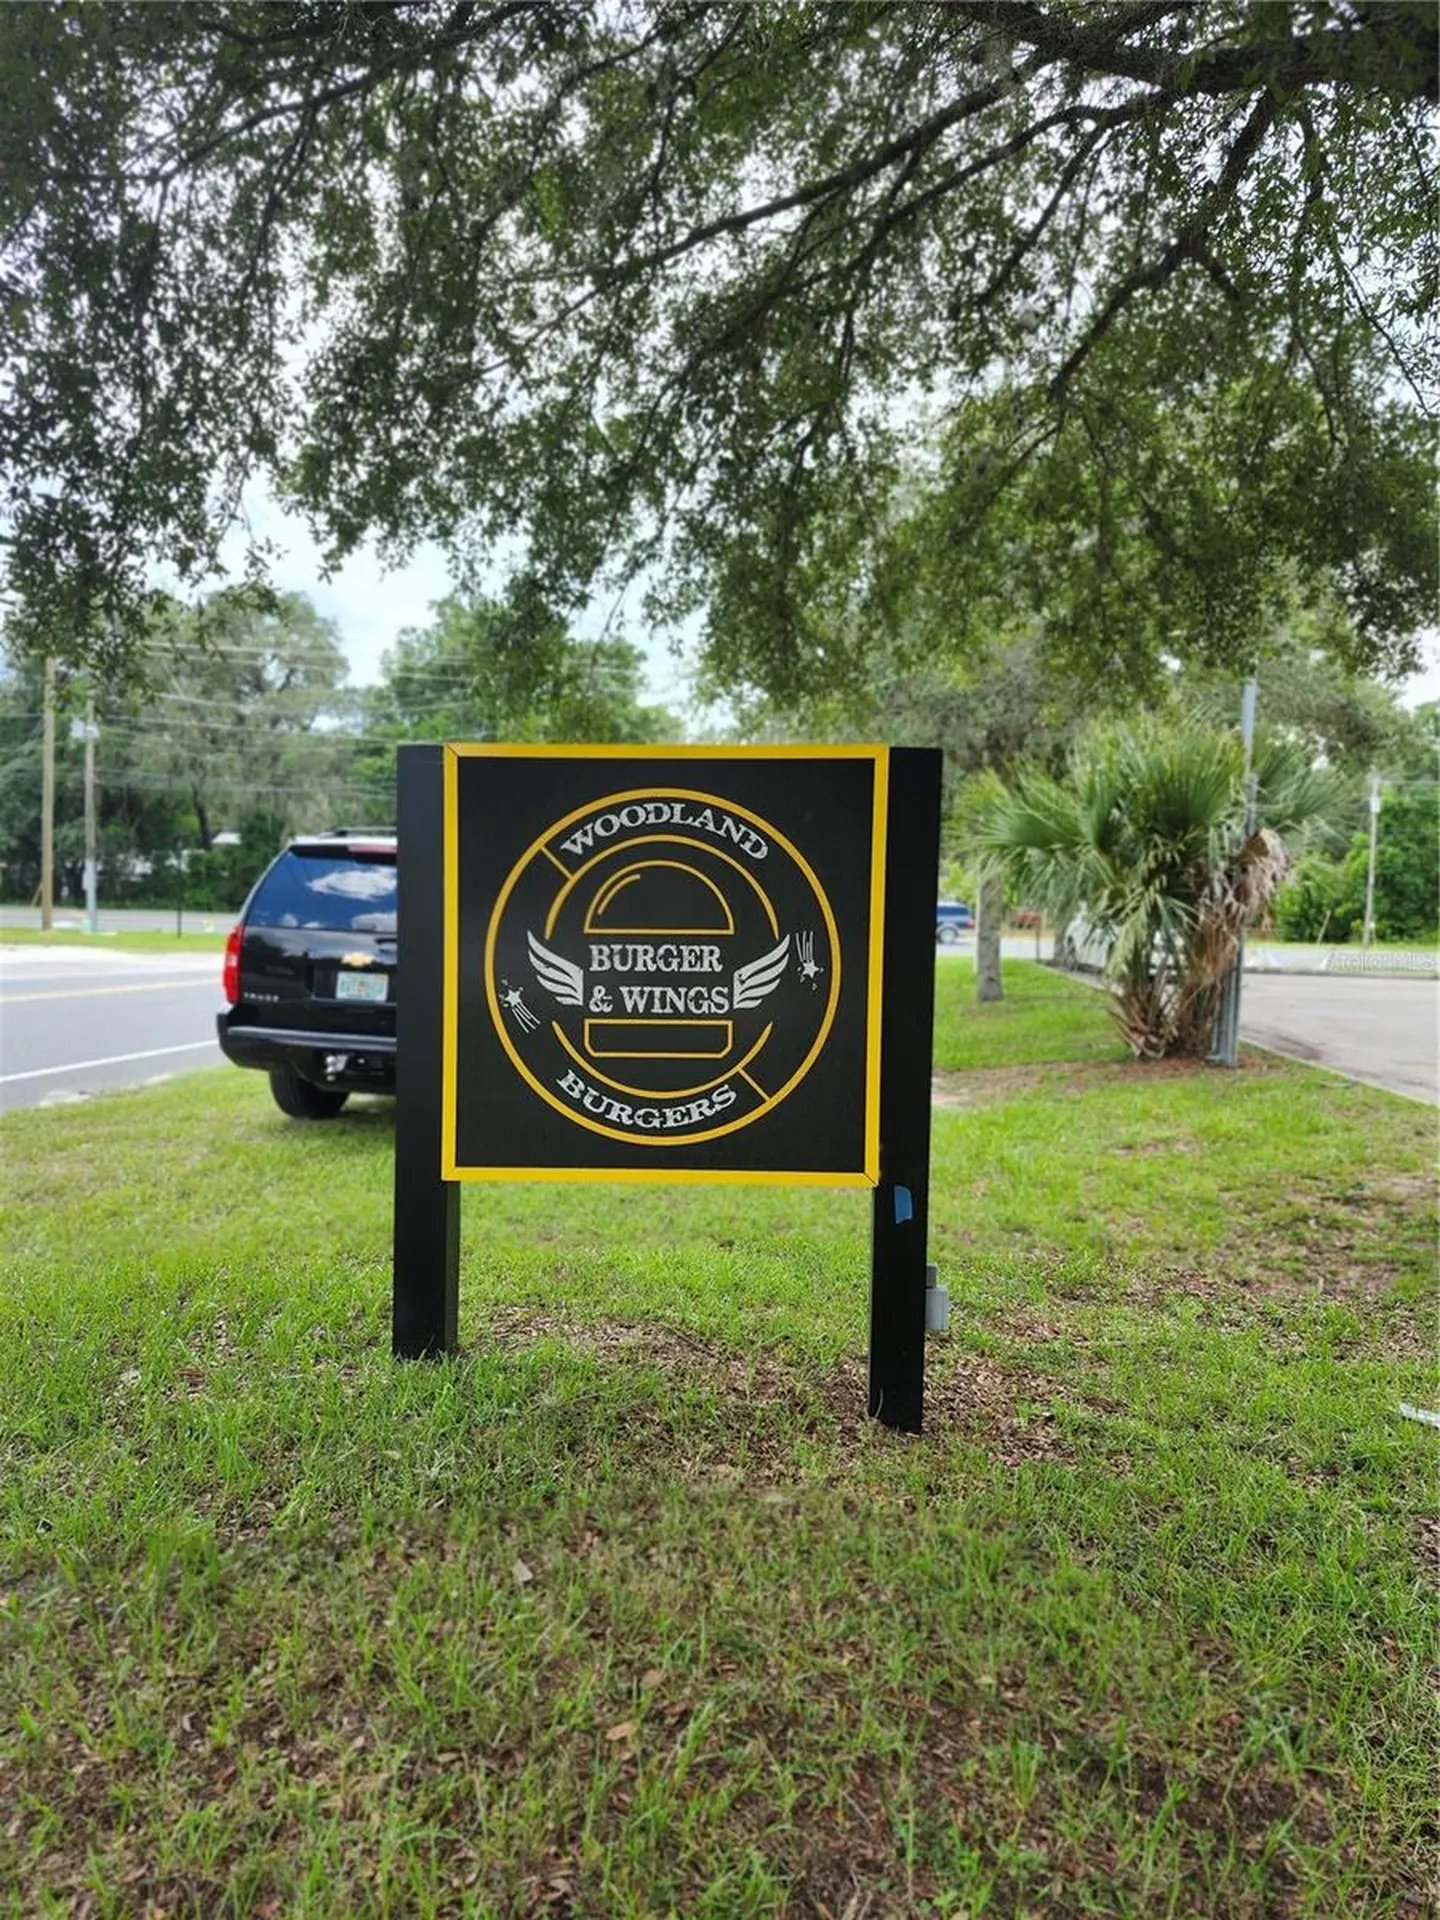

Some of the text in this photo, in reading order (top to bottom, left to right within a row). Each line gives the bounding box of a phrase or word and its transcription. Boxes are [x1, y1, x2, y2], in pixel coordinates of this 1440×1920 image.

[560, 802, 769, 860] WOODLAND
[588, 944, 724, 973] BURGER
[588, 984, 730, 1015] & WINGS
[555, 1069, 737, 1129] BURGERS
